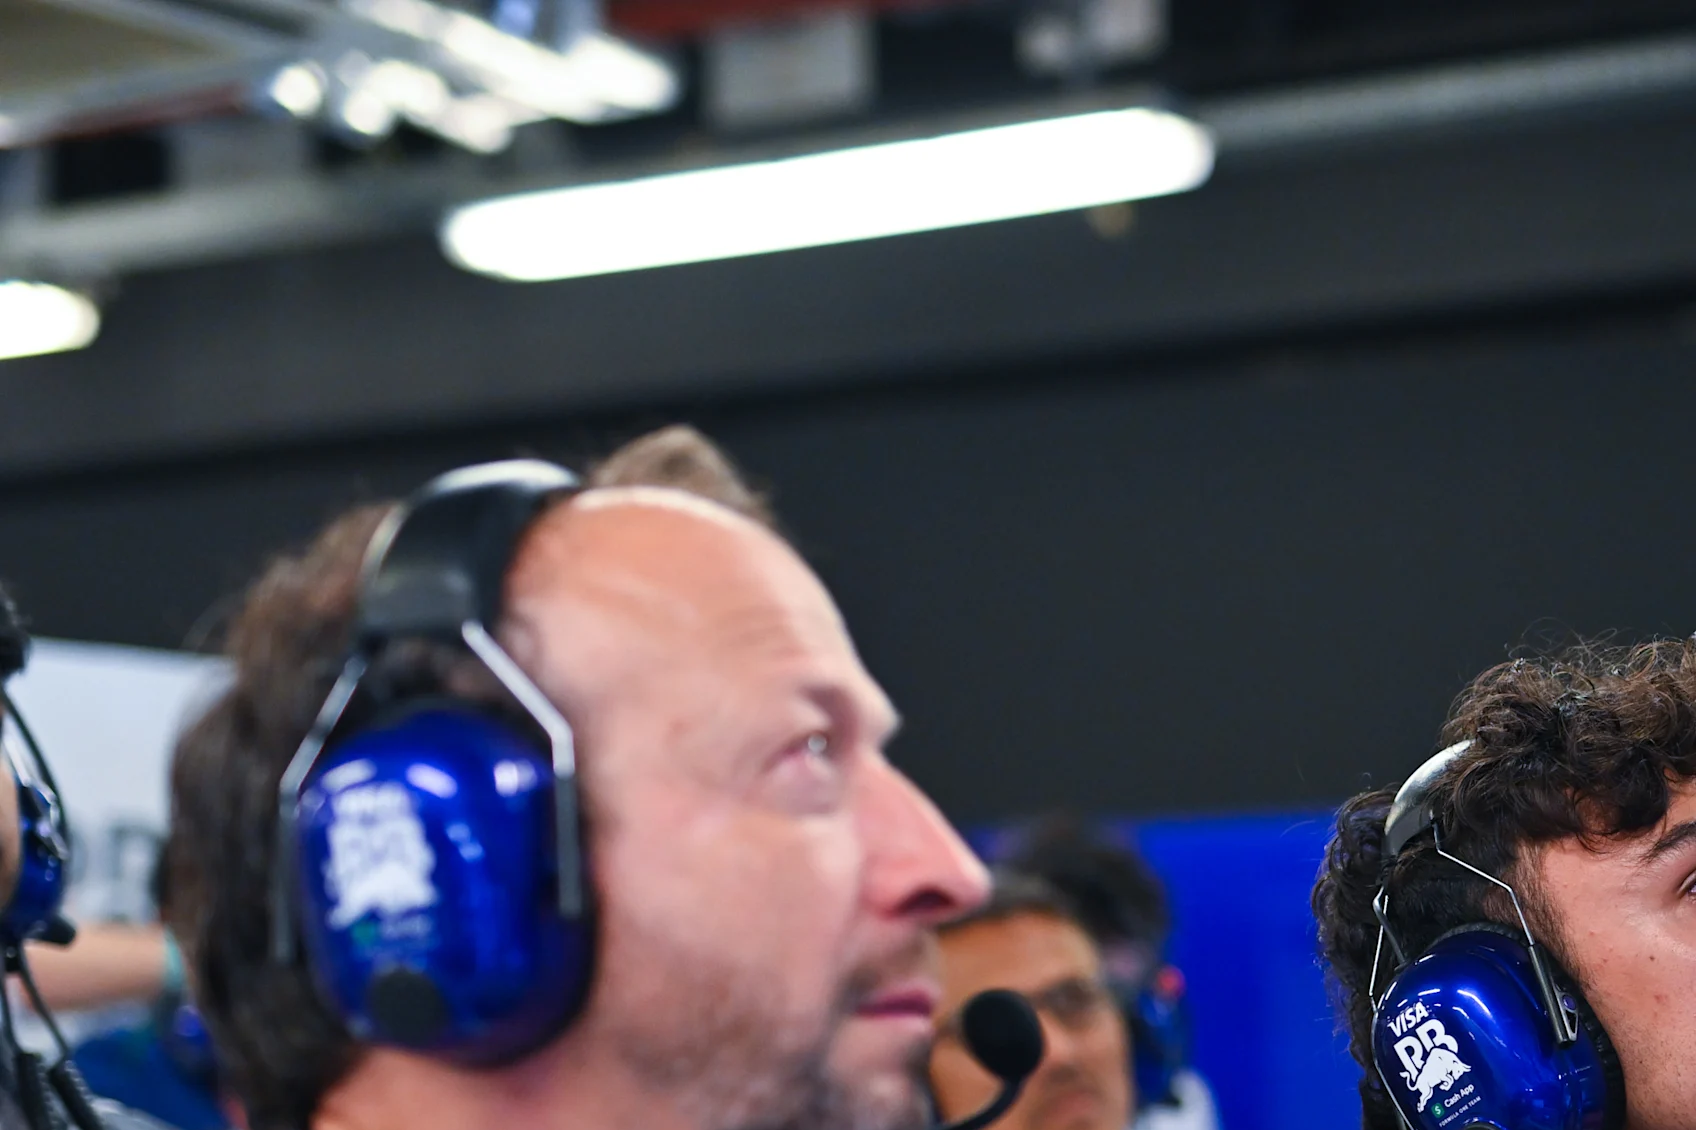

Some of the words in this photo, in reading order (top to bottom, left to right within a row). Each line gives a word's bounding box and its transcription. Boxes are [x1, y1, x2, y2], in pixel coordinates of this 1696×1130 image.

[1387, 1002, 1429, 1037] VISA
[1444, 1093, 1461, 1108] Cash
[1459, 1083, 1475, 1099] App
[1439, 1111, 1460, 1128] FORMULA
[1458, 1104, 1469, 1115] ONE
[1468, 1096, 1481, 1107] TEAM
